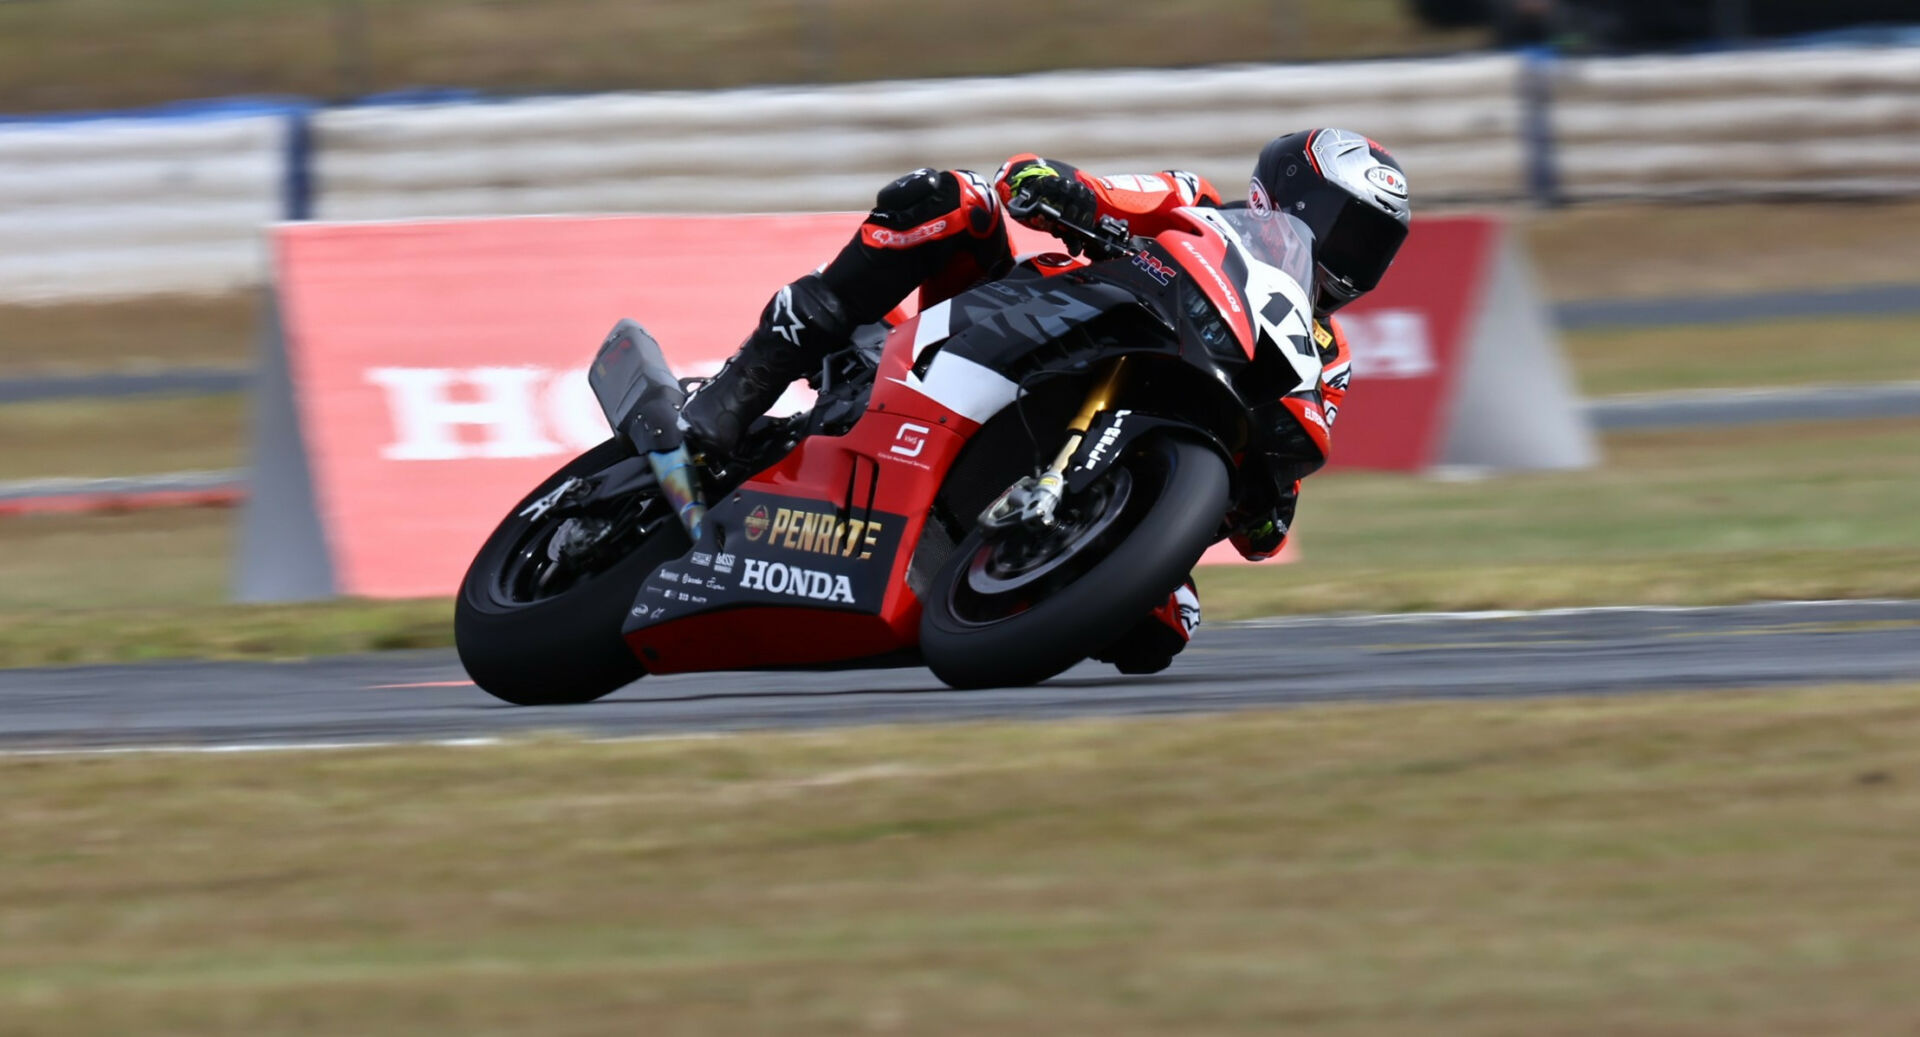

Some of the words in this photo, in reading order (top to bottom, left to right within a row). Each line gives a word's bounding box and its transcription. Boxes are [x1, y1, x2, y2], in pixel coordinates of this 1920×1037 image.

[1370, 166, 1407, 195] SUOM
[1131, 249, 1177, 287] HRC
[1259, 291, 1316, 358] 17
[739, 558, 856, 604] HONDA
